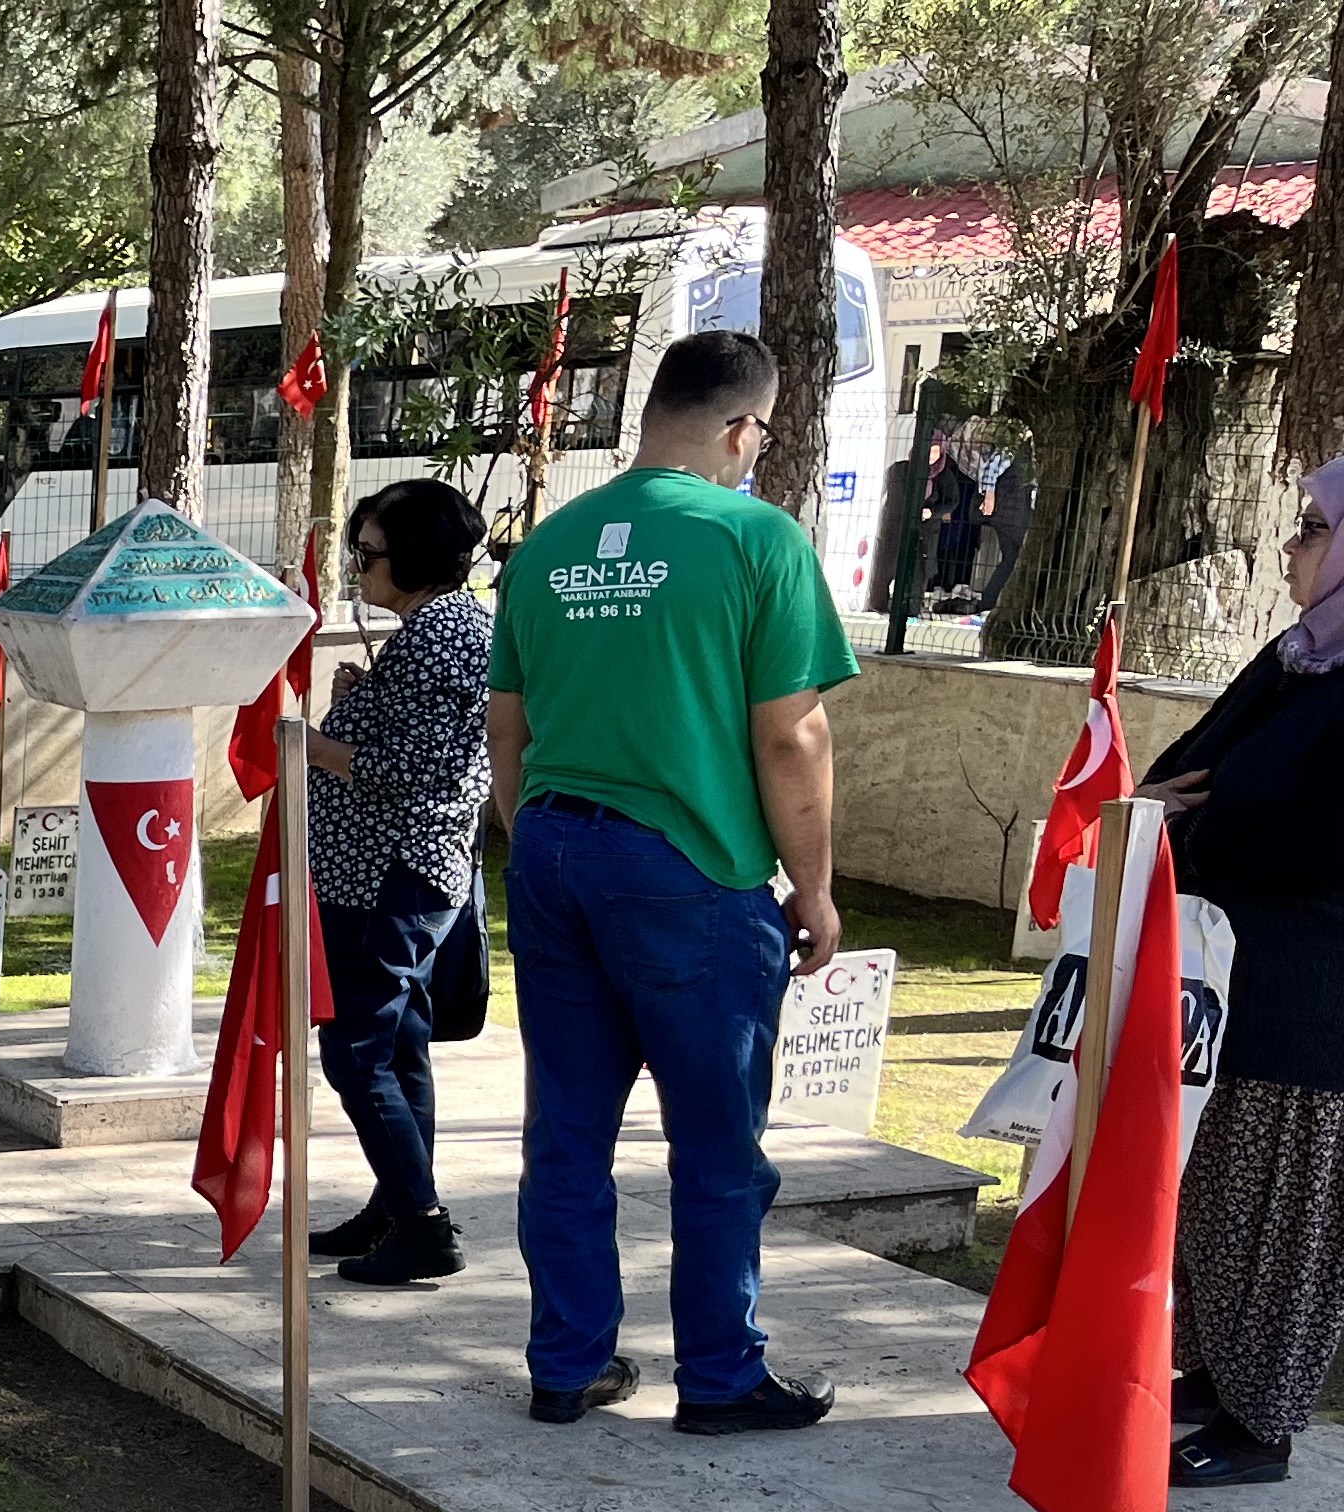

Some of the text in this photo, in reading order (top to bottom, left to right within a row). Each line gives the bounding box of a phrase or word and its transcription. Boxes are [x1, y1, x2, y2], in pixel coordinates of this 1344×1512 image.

[566, 604, 641, 620] 444 96 13
[33, 833, 69, 854] ŞEHİT
[33, 887, 65, 899] 1336
[805, 1079, 849, 1097] 1336
